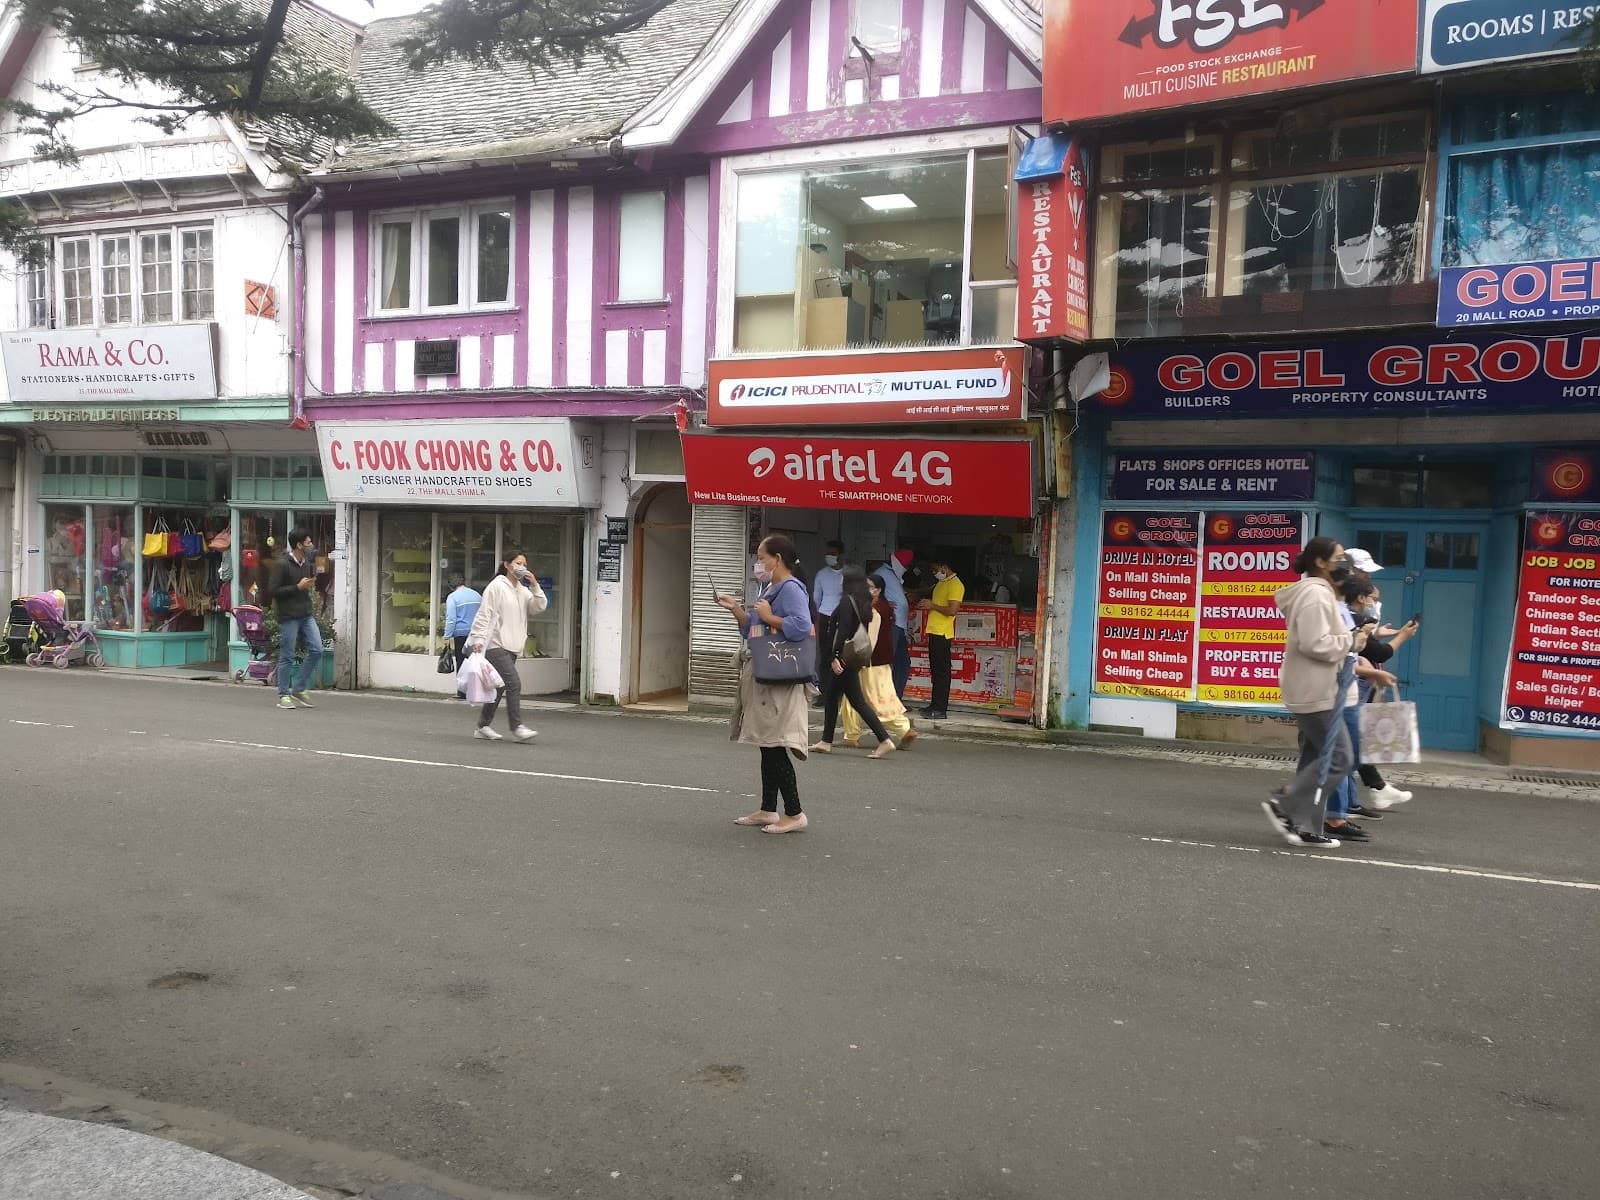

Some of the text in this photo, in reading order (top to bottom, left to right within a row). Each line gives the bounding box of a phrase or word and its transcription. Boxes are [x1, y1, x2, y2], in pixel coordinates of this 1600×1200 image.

[1446, 13, 1534, 45] ROOMS
[1155, 46, 1283, 76] FOOD STOCK EXCHANGE
[1123, 54, 1317, 100] MULTI CUISINE RESTAURANT
[1031, 182, 1054, 335] RESTAURANT
[1456, 261, 1600, 308] GOE
[1455, 312, 1470, 323] 20
[1472, 310, 1507, 322] MALL
[1509, 308, 1546, 319] ROAD
[104, 341, 123, 367] &
[21, 372, 196, 384] STATIONERS HANDICRAFTS GIFTS
[1157, 349, 1345, 392] GOEL
[747, 378, 998, 398] ICICI PRUDENTIAL MUTUAL FUND
[1164, 385, 1600, 408] BUILDERS PROPERTY CONSULTANTS HOT
[330, 439, 351, 471] C.
[353, 439, 411, 471] FOOK
[415, 439, 492, 472] CHONG
[499, 439, 517, 472] &
[522, 439, 563, 473] CO.
[784, 444, 953, 486] airtel 4G
[1119, 458, 1309, 472] FLATS SHOPS OFFICES HOTEL
[361, 476, 533, 487] DESIGNER HANDCRAFTED SHOES
[1146, 477, 1278, 491] FOR SALE & RENT
[435, 487, 456, 496] MALL
[457, 488, 486, 496] SHIMLA
[694, 491, 786, 504] New Lite Business Center
[819, 489, 953, 504] THE SMARTPHONE NETWORK
[1145, 517, 1192, 528] GOEL
[1213, 519, 1230, 535] G
[1244, 514, 1291, 525] GOEL
[1113, 521, 1129, 536] G
[1138, 530, 1198, 542] GROUP
[1237, 527, 1297, 539] GROUP
[1568, 533, 1600, 547] GR
[1103, 551, 1196, 567] DRIVE IN HOTEL
[1208, 551, 1290, 571] ROOMS
[1526, 555, 1596, 570] JOB JOB
[1106, 571, 1192, 585] On Mall Shimla
[1549, 576, 1571, 587] FOR
[1108, 587, 1187, 603] Selling Cheap
[1227, 584, 1256, 593] 98162
[1527, 591, 1577, 605] Tandoor
[1120, 606, 1190, 619] 98162 44444
[1525, 607, 1575, 621] Chinese
[1103, 626, 1189, 642] DRIVE IN FLAT
[1224, 631, 1247, 640] 0177
[1529, 622, 1567, 635] Indian
[1531, 636, 1579, 651] Service
[1102, 648, 1188, 664] On Mall Shimla
[1518, 652, 1535, 661] FOR
[1536, 654, 1560, 664] SHOP
[1561, 656, 1569, 664] &
[1104, 664, 1184, 682] Selling Cheap
[1211, 666, 1237, 678] BUY
[1240, 667, 1250, 678] &
[1541, 668, 1593, 684] Manager
[1143, 687, 1187, 699] 2654444
[1223, 689, 1256, 700] 98160
[1515, 680, 1548, 693] Sales
[1550, 683, 1579, 696] Girls
[1544, 695, 1584, 708] Helper
[1529, 710, 1570, 725] 98162
